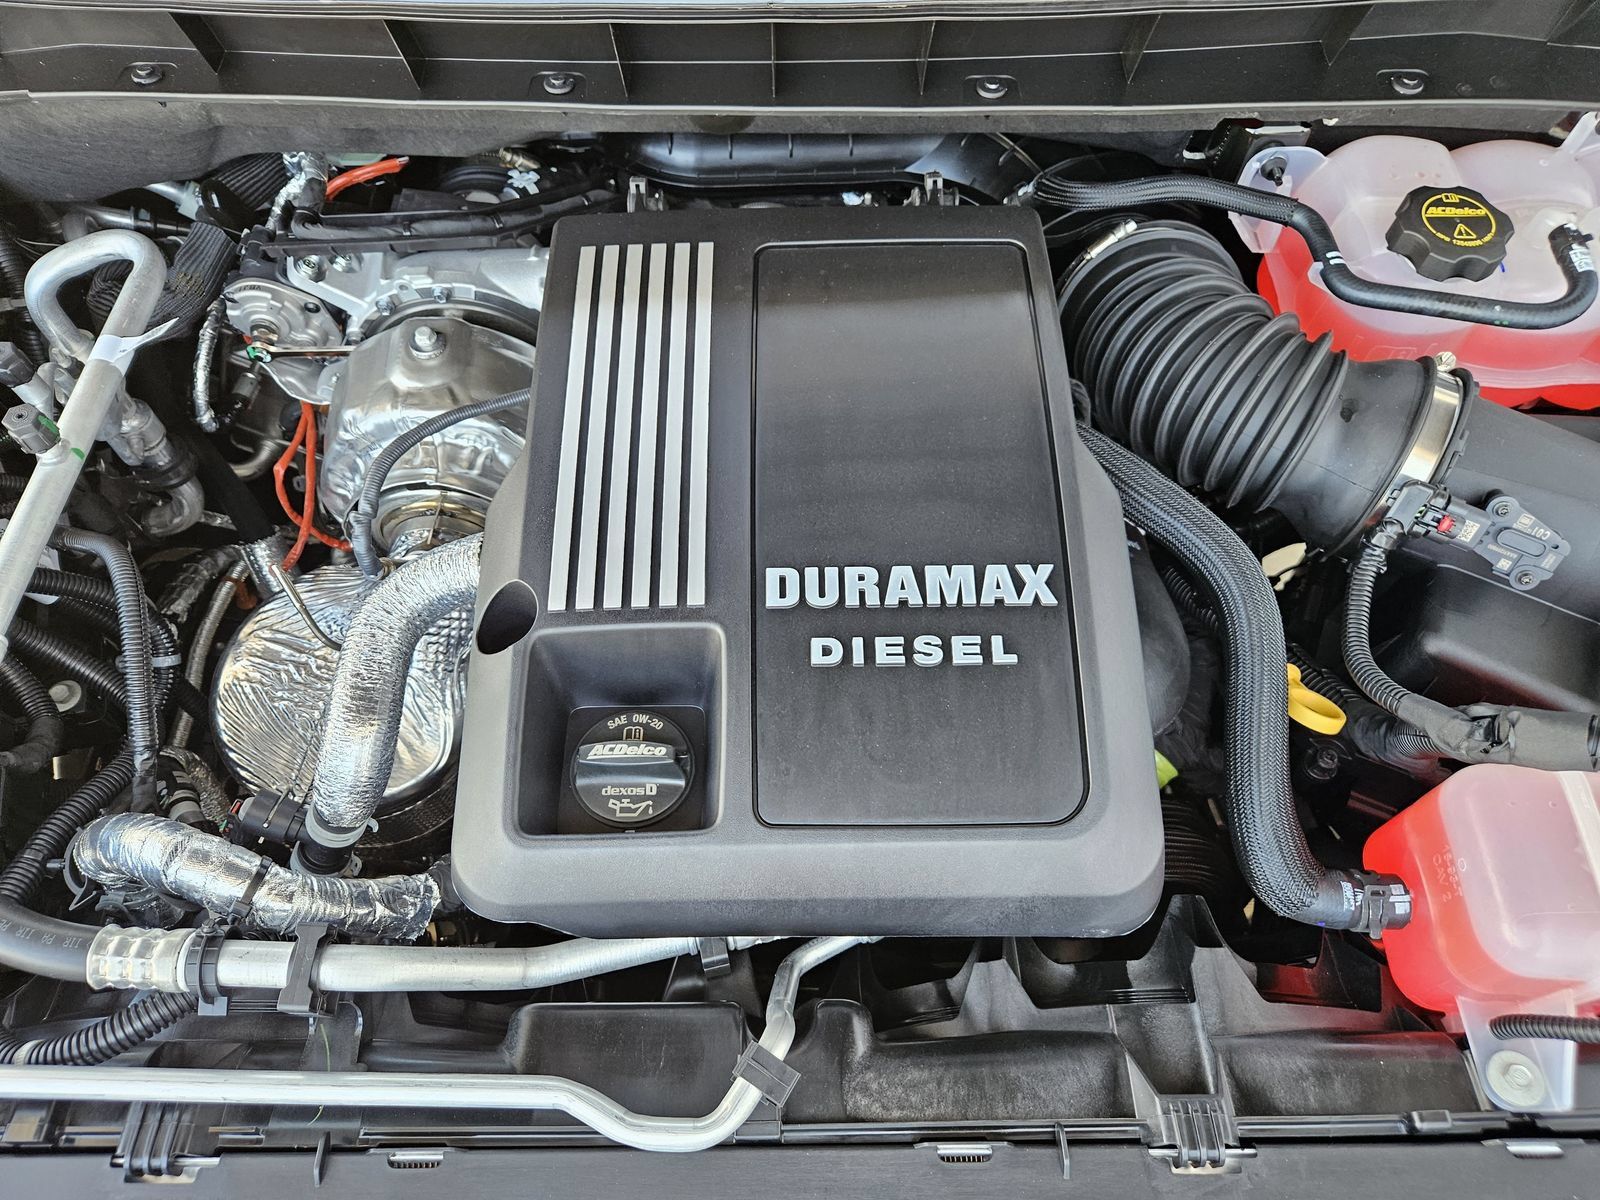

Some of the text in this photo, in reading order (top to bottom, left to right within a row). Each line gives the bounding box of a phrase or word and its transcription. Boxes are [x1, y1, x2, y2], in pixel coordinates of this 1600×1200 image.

[1426, 206, 1486, 216] ACDelco
[765, 563, 1059, 610] DURAMAX
[811, 635, 1018, 668] DIESEL
[608, 714, 664, 730] SAE 0W-20
[588, 744, 667, 758] ACDelco
[602, 784, 657, 795] dexosD
